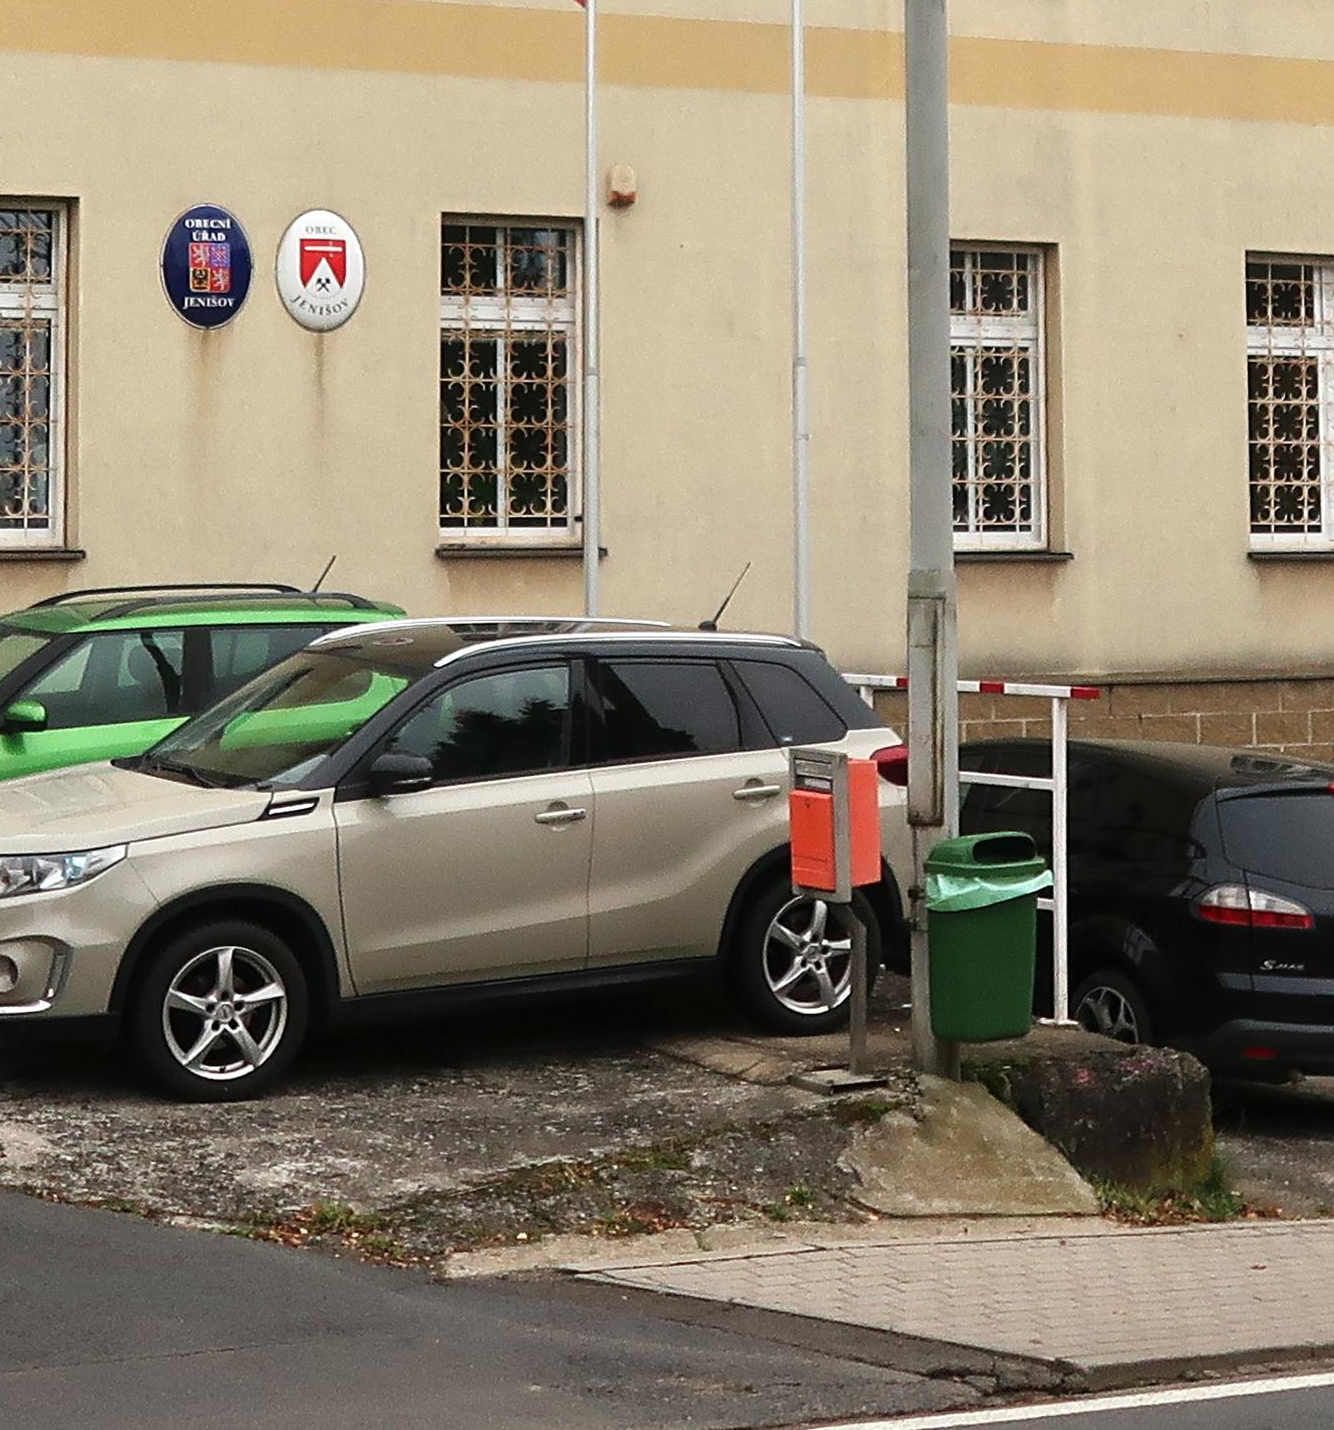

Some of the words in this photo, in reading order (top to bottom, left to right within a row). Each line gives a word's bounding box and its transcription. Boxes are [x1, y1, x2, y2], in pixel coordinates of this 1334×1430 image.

[184, 217, 231, 229] OBECNÍ
[192, 230, 226, 241] ÚŘAD
[305, 225, 337, 235] OBEC
[182, 295, 235, 310] JENIŠOV
[289, 295, 348, 316] JENIŠOV
